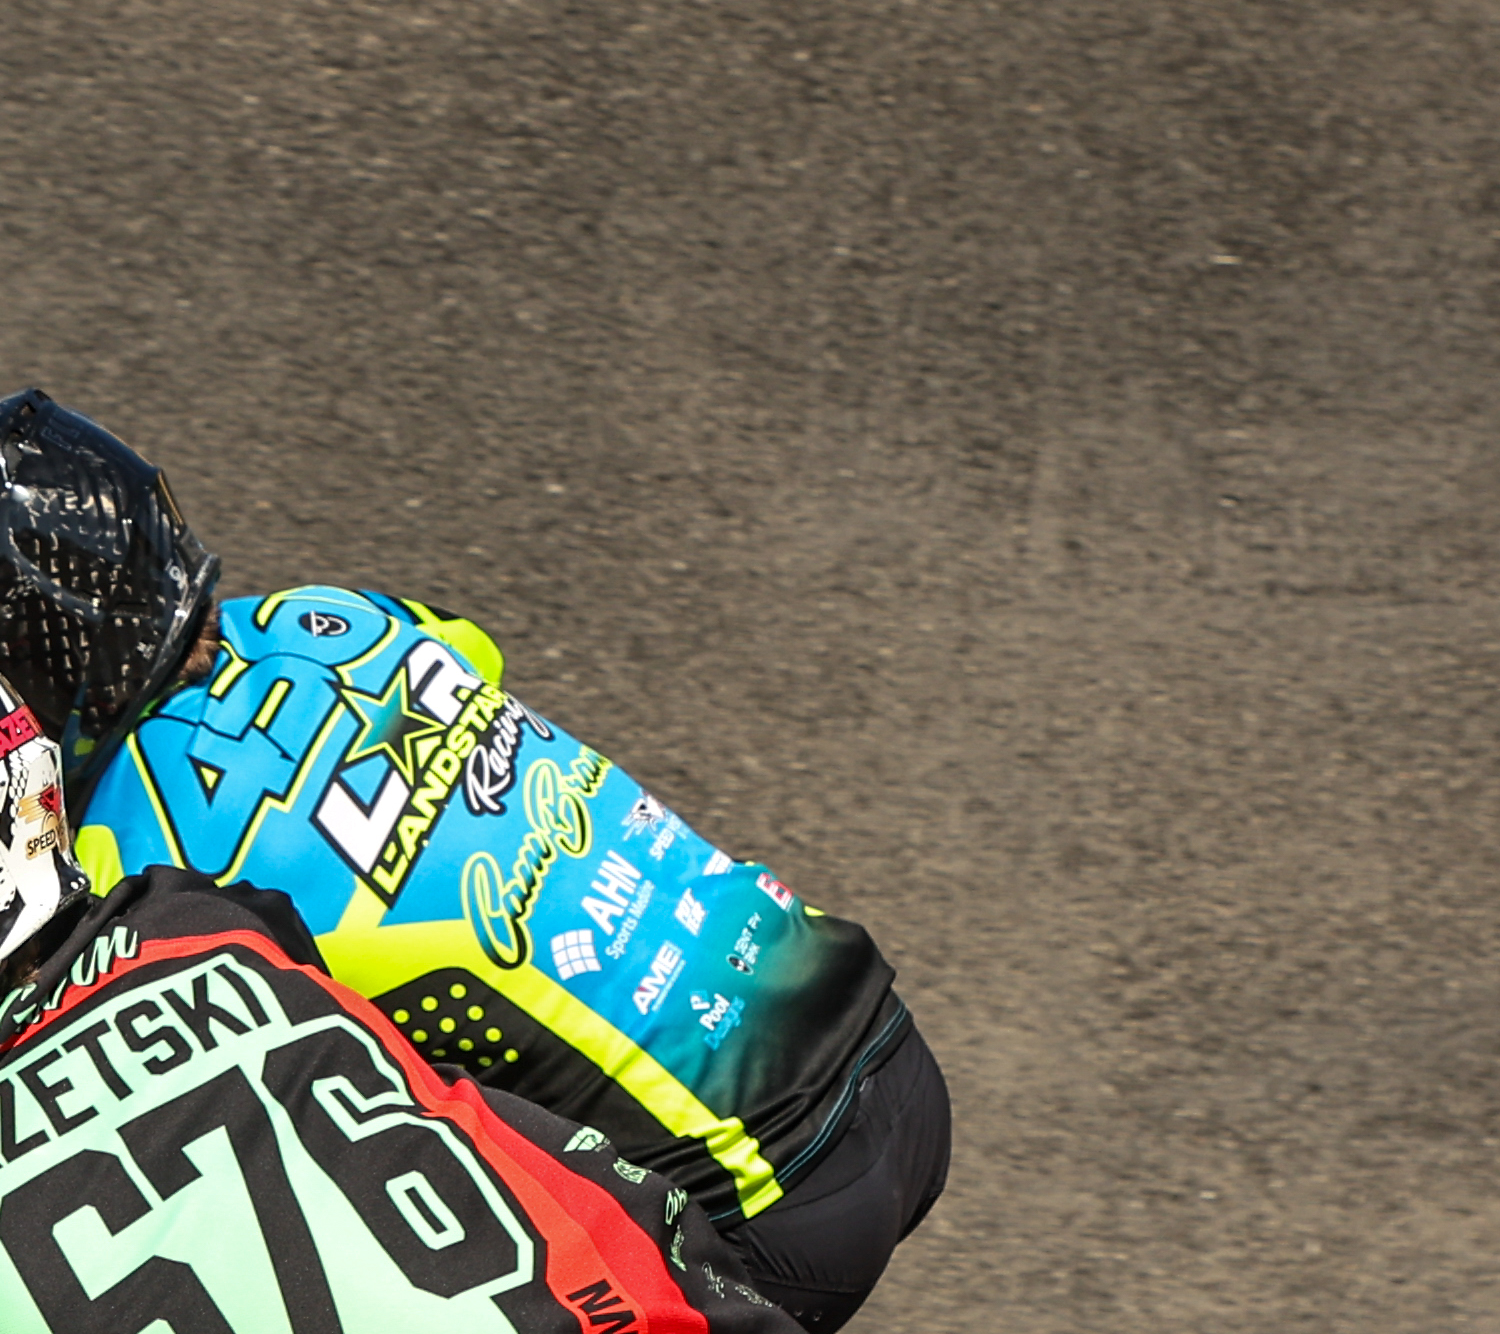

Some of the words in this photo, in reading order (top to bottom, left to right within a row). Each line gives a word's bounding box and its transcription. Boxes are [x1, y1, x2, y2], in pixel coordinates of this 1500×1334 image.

[371, 683, 508, 896] LANDSTAR
[27, 826, 56, 857] SPEED
[581, 848, 643, 937] AHN
[604, 916, 640, 960] Sports
[633, 939, 682, 1016] AME
[698, 993, 731, 1032] Pool
